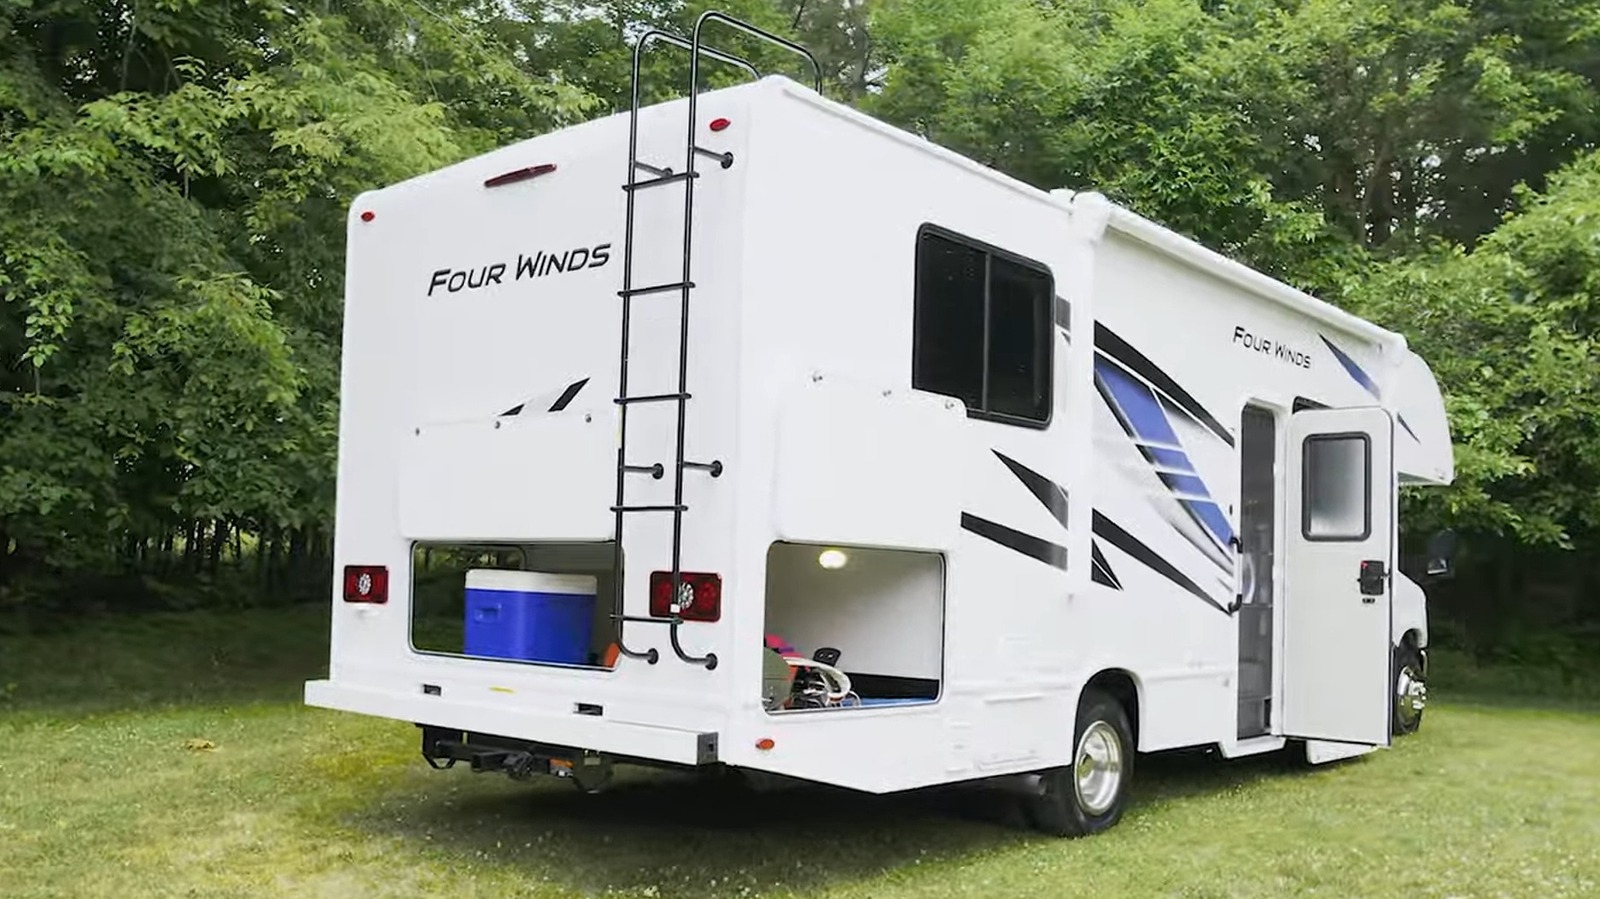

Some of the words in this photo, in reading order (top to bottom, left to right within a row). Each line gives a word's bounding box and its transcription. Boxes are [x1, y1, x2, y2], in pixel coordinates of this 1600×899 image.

[428, 263, 506, 296] FOUR
[515, 243, 611, 281] WINDS
[1233, 326, 1271, 354] FOUR
[1275, 341, 1311, 369] WINDS
